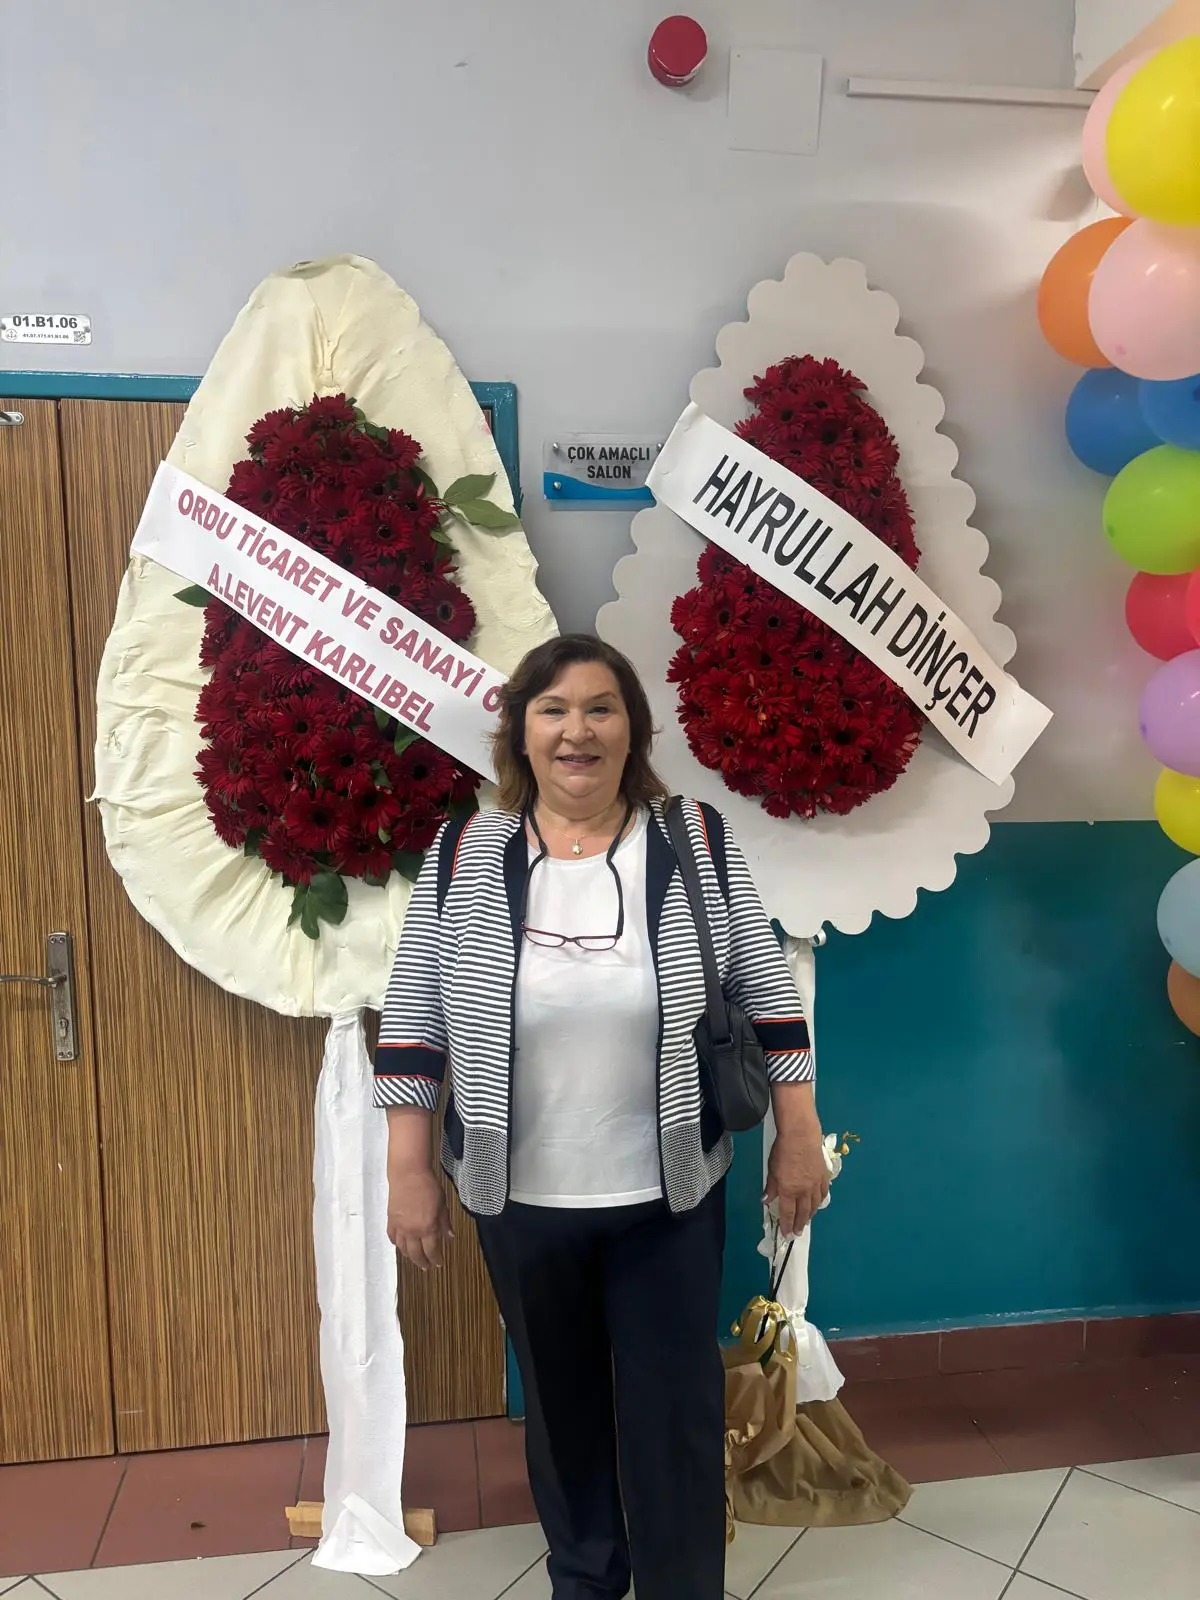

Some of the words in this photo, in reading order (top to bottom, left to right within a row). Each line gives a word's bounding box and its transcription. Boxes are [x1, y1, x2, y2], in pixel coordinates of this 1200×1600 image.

[12, 315, 78, 329] 01.B1.06
[567, 446, 595, 463] ÇOK
[598, 446, 650, 464] AMAÇLI
[587, 465, 631, 479] SALON
[178, 488, 237, 541] ORDU
[240, 526, 342, 604] TİCARET
[340, 588, 382, 631] VE
[379, 616, 487, 699] SANAYİ
[692, 454, 905, 637] HAYRULLAH
[886, 602, 997, 739] DİNÇER
[206, 563, 309, 644] A.LEVENT
[303, 629, 435, 732] KARLIBEL
